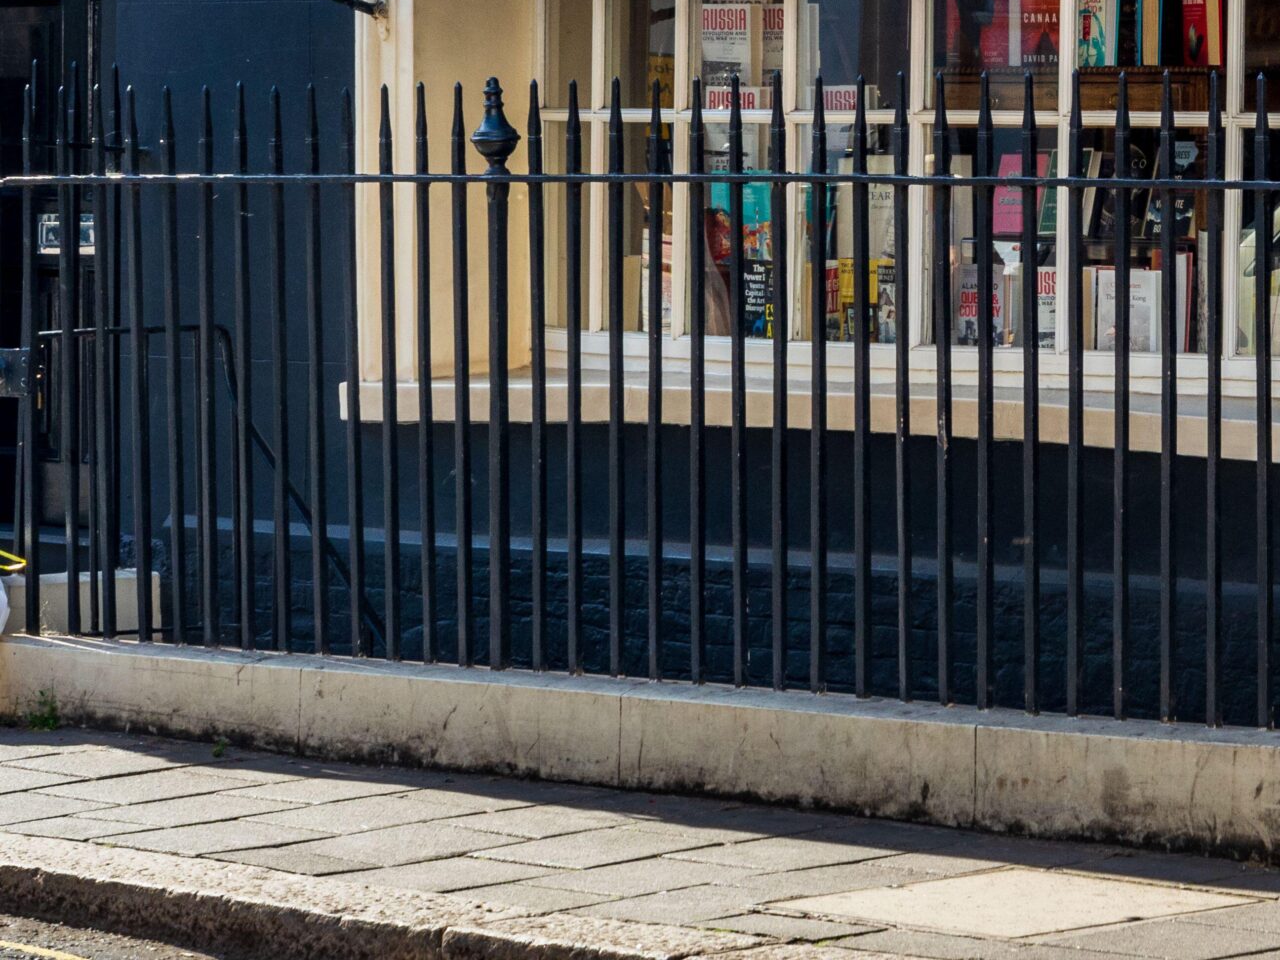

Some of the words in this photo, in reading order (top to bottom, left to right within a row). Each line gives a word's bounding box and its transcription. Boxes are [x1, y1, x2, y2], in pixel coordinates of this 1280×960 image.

[703, 8, 746, 30] RUSSIA
[1023, 13, 1058, 23] CANAA
[1023, 55, 1046, 63] DAVID
[1049, 54, 1058, 62] PA
[709, 91, 755, 110] RUSIA
[753, 264, 765, 272] The
